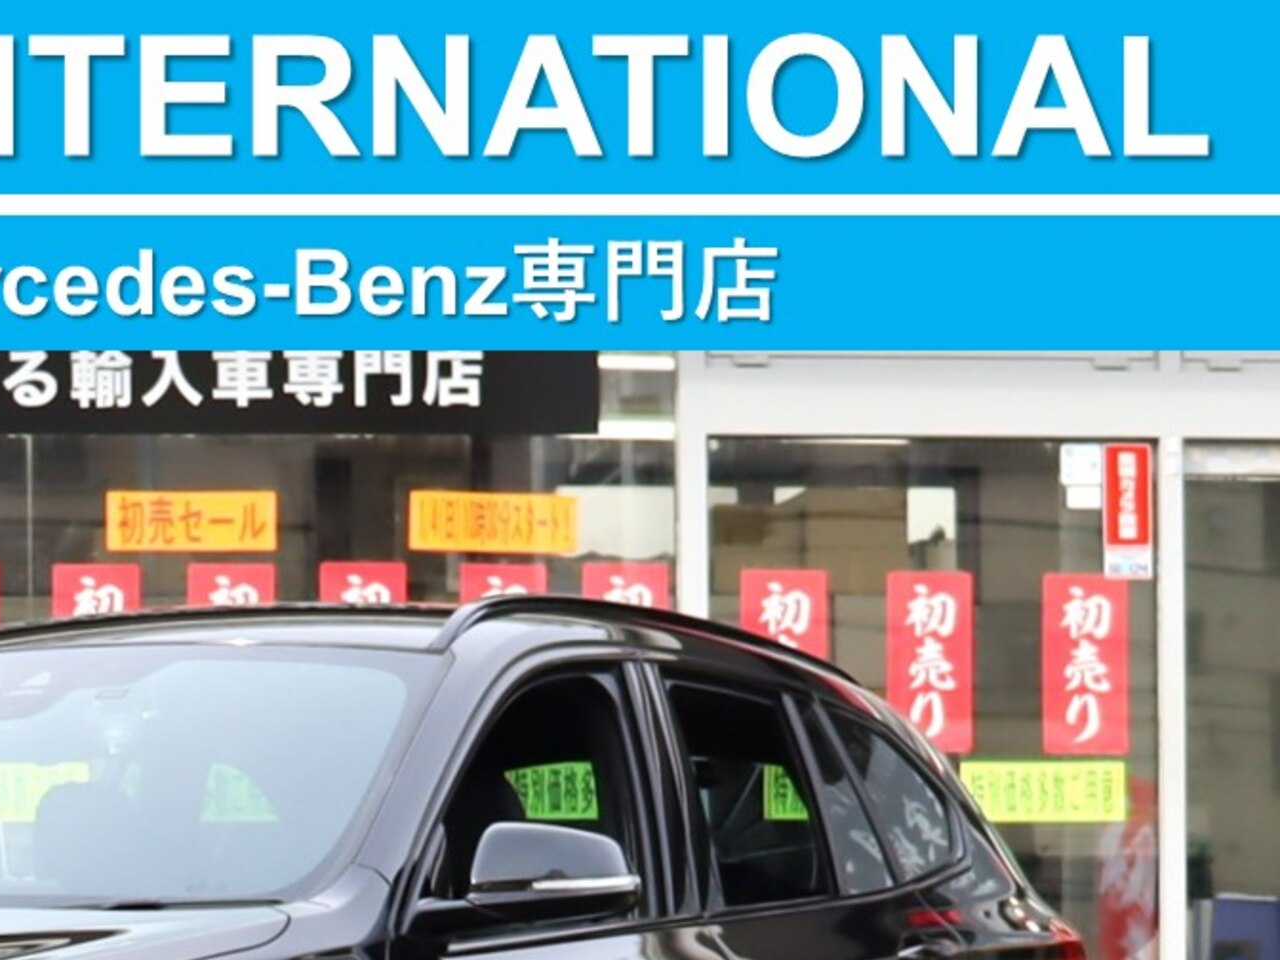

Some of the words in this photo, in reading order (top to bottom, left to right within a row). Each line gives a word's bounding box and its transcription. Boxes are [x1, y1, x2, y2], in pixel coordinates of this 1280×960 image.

[118, 496, 268, 544] 初売セール
[904, 583, 956, 738] 初売り
[1060, 586, 1111, 743] 初売り
